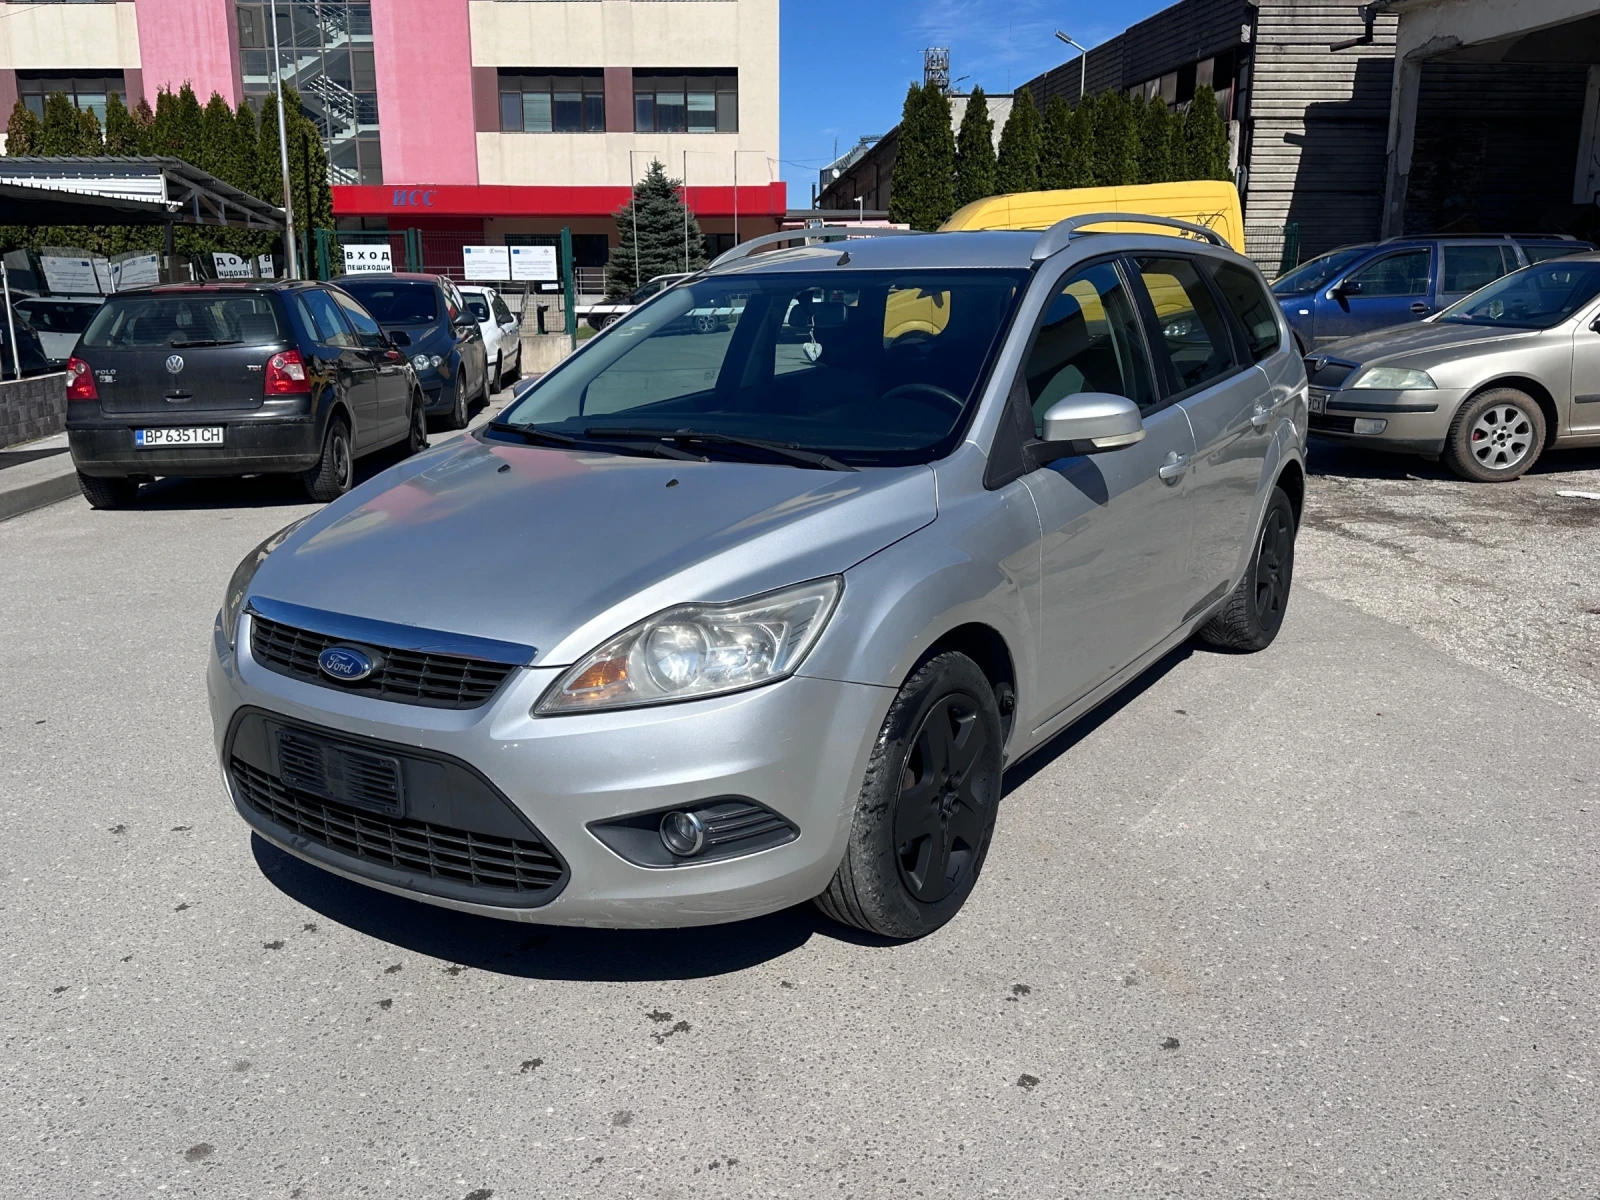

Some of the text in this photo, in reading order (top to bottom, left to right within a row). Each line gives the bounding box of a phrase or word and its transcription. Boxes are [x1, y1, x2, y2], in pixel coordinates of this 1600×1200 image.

[392, 189, 438, 207] ИСС
[346, 251, 390, 261] ВХОД
[145, 427, 220, 444] BP 6351 CH
[326, 653, 354, 673] Ford
